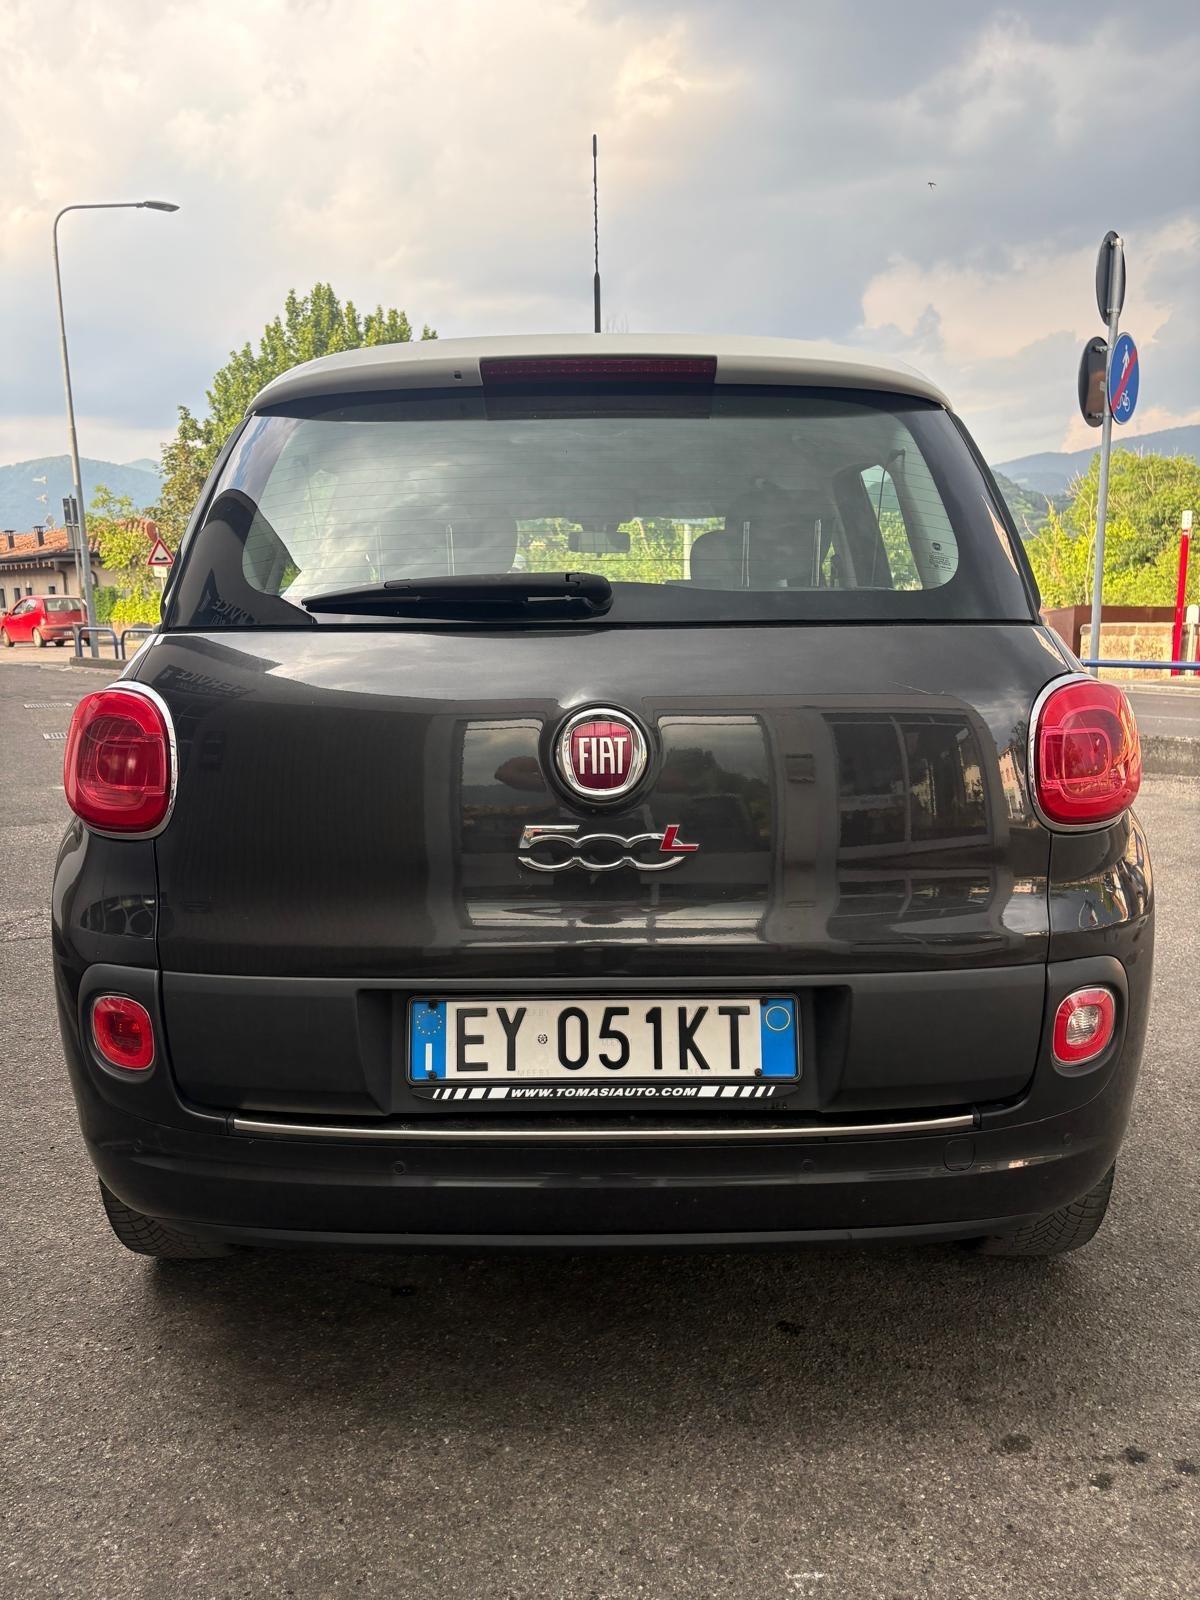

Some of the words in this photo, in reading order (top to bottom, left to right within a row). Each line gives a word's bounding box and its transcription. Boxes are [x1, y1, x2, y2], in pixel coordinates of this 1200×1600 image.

[578, 737, 628, 775] FIAT
[518, 824, 700, 872] 500L
[456, 1007, 527, 1072] EY
[557, 1006, 751, 1071] 051KT
[510, 1087, 698, 1098] WWW.TOMASIAUTO.COM
